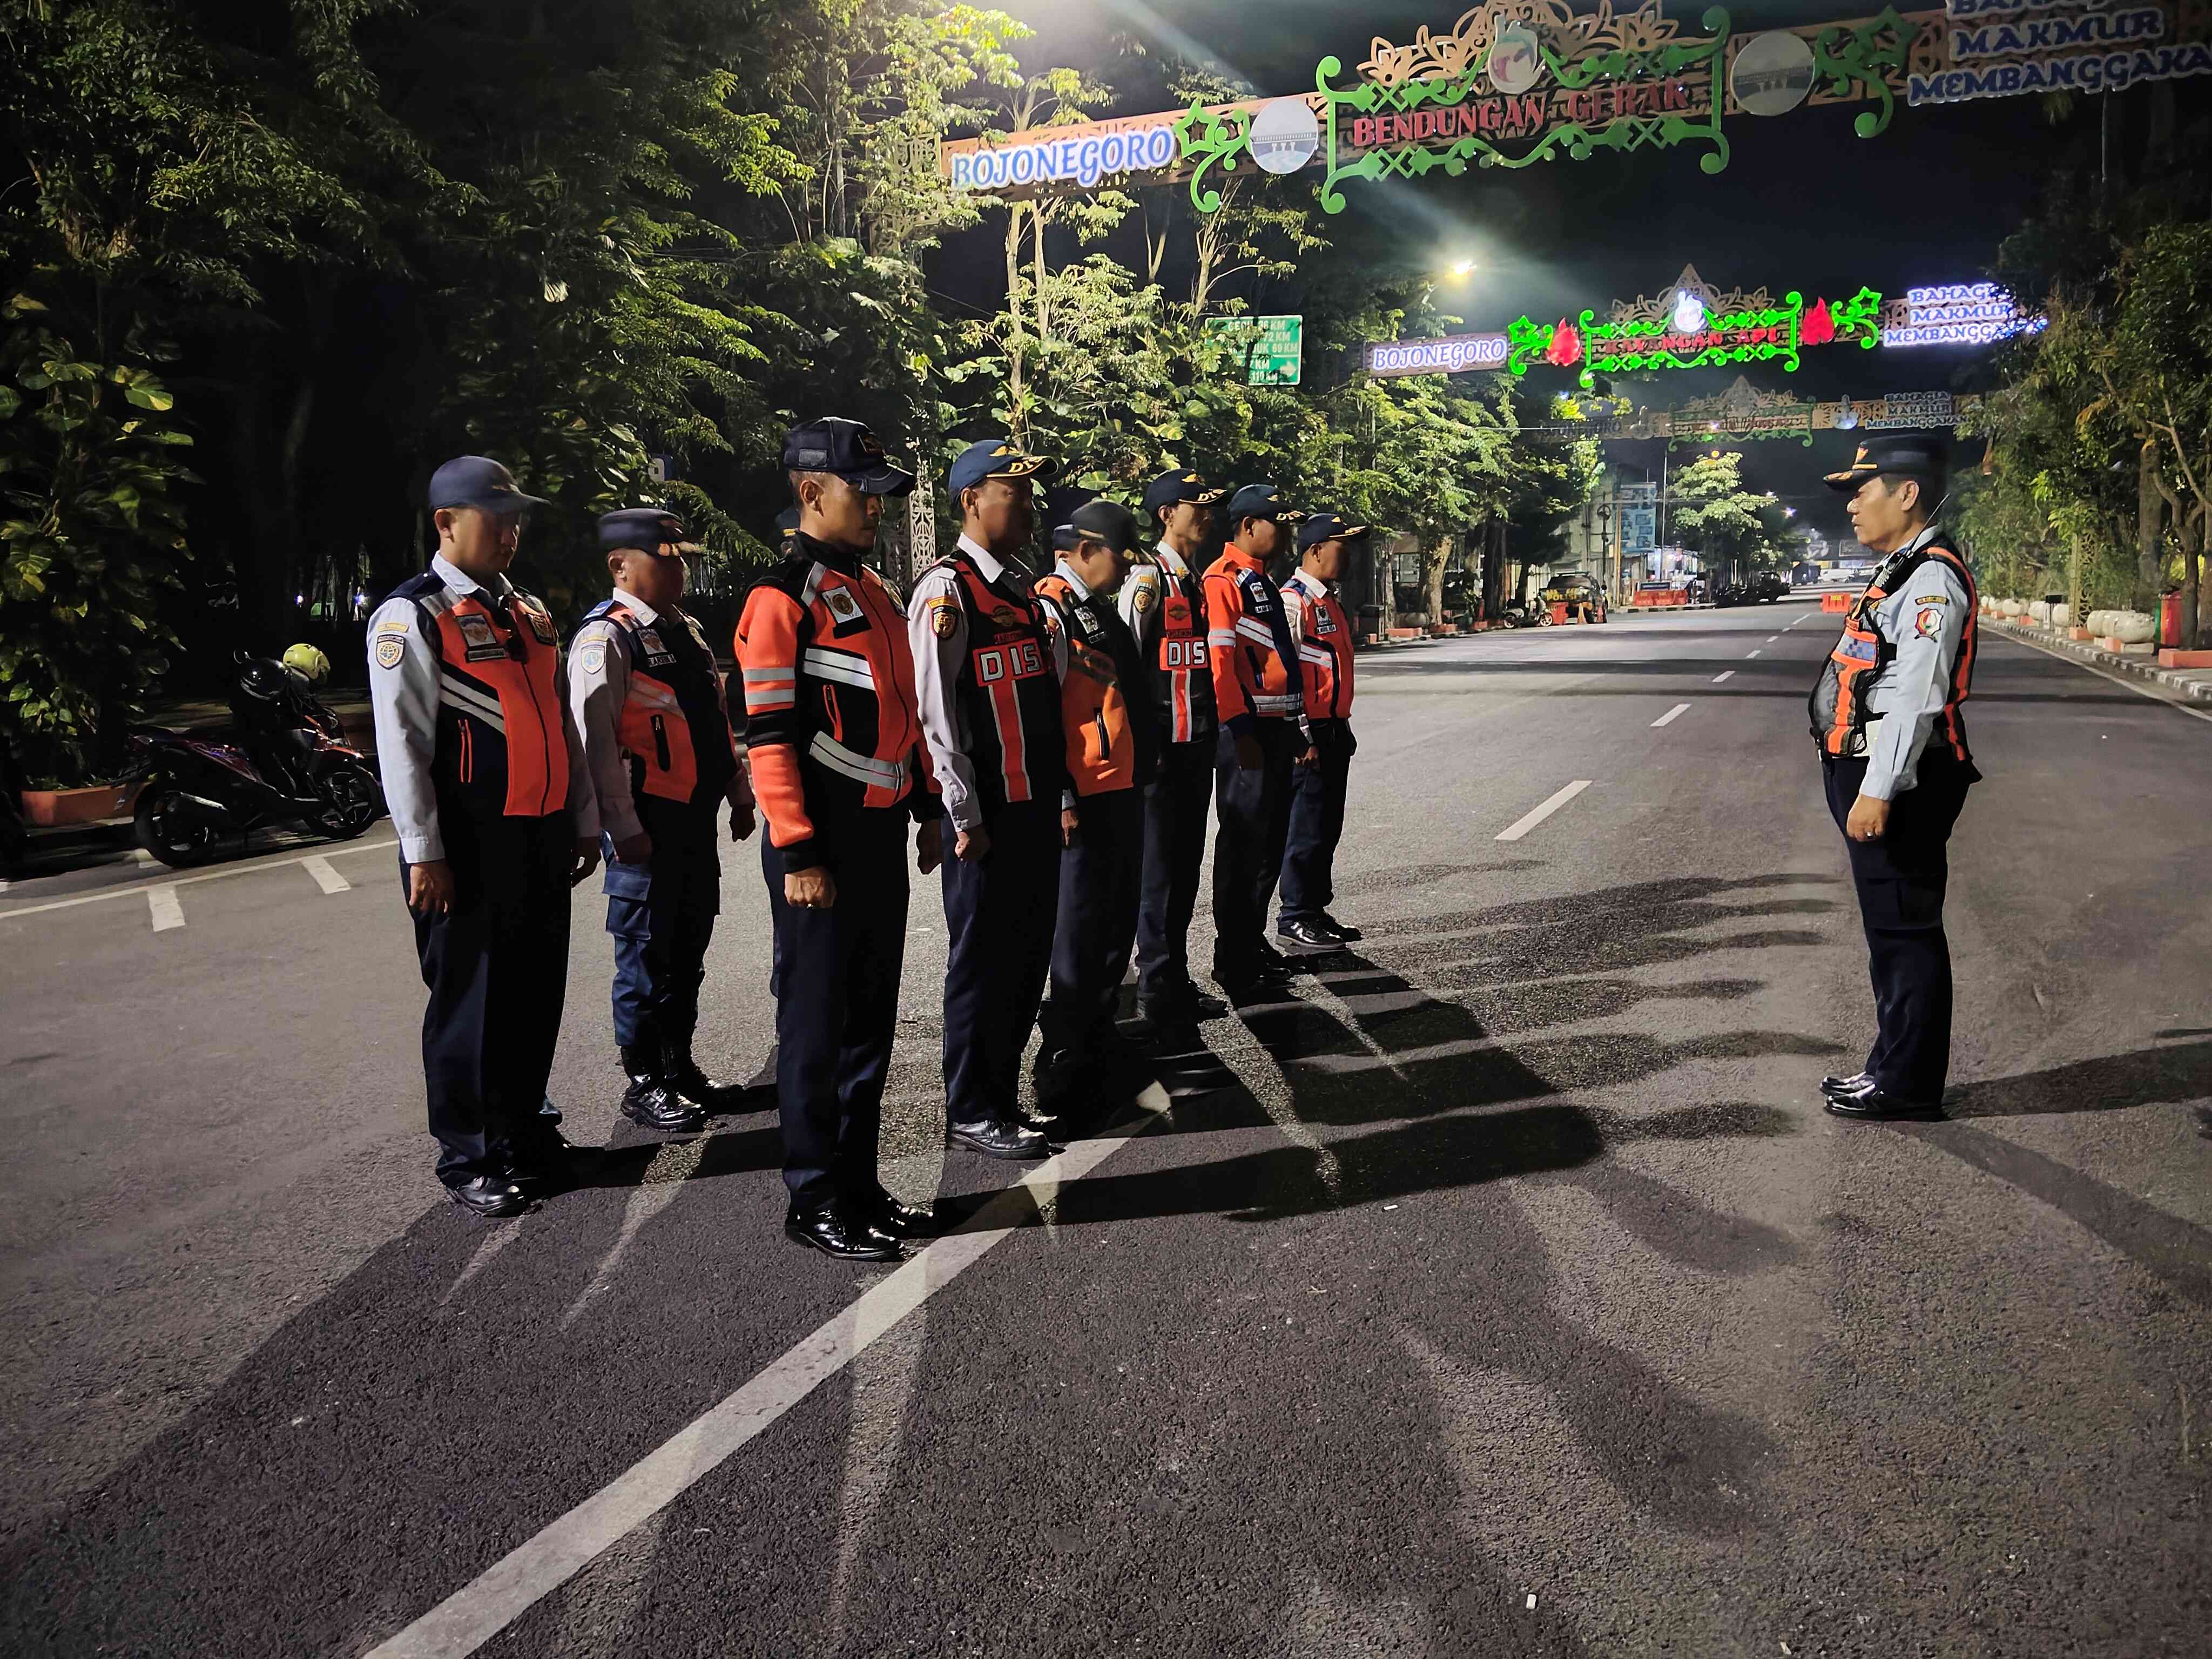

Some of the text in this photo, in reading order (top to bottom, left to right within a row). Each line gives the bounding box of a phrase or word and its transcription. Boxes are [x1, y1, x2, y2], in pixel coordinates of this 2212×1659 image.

[1956, 11, 2160, 56] MAKMUR
[1353, 78, 1690, 147] BENDUNGAN GERAK
[953, 130, 1174, 187] BOJONEGORO
[1911, 283, 2005, 302] BAHAG
[1271, 320, 1285, 330] KM
[1276, 331, 1290, 341] KM
[1886, 321, 2033, 345] MEMBANGG
[1284, 342, 1299, 353] KM
[1604, 328, 1781, 354] KAYANGAN API
[1256, 358, 1270, 369] KM
[1373, 339, 1506, 369] BOJONEGORO
[1889, 403, 1951, 415] MAKMUR
[980, 644, 1041, 682] DIS
[1168, 641, 1205, 665] DIS
